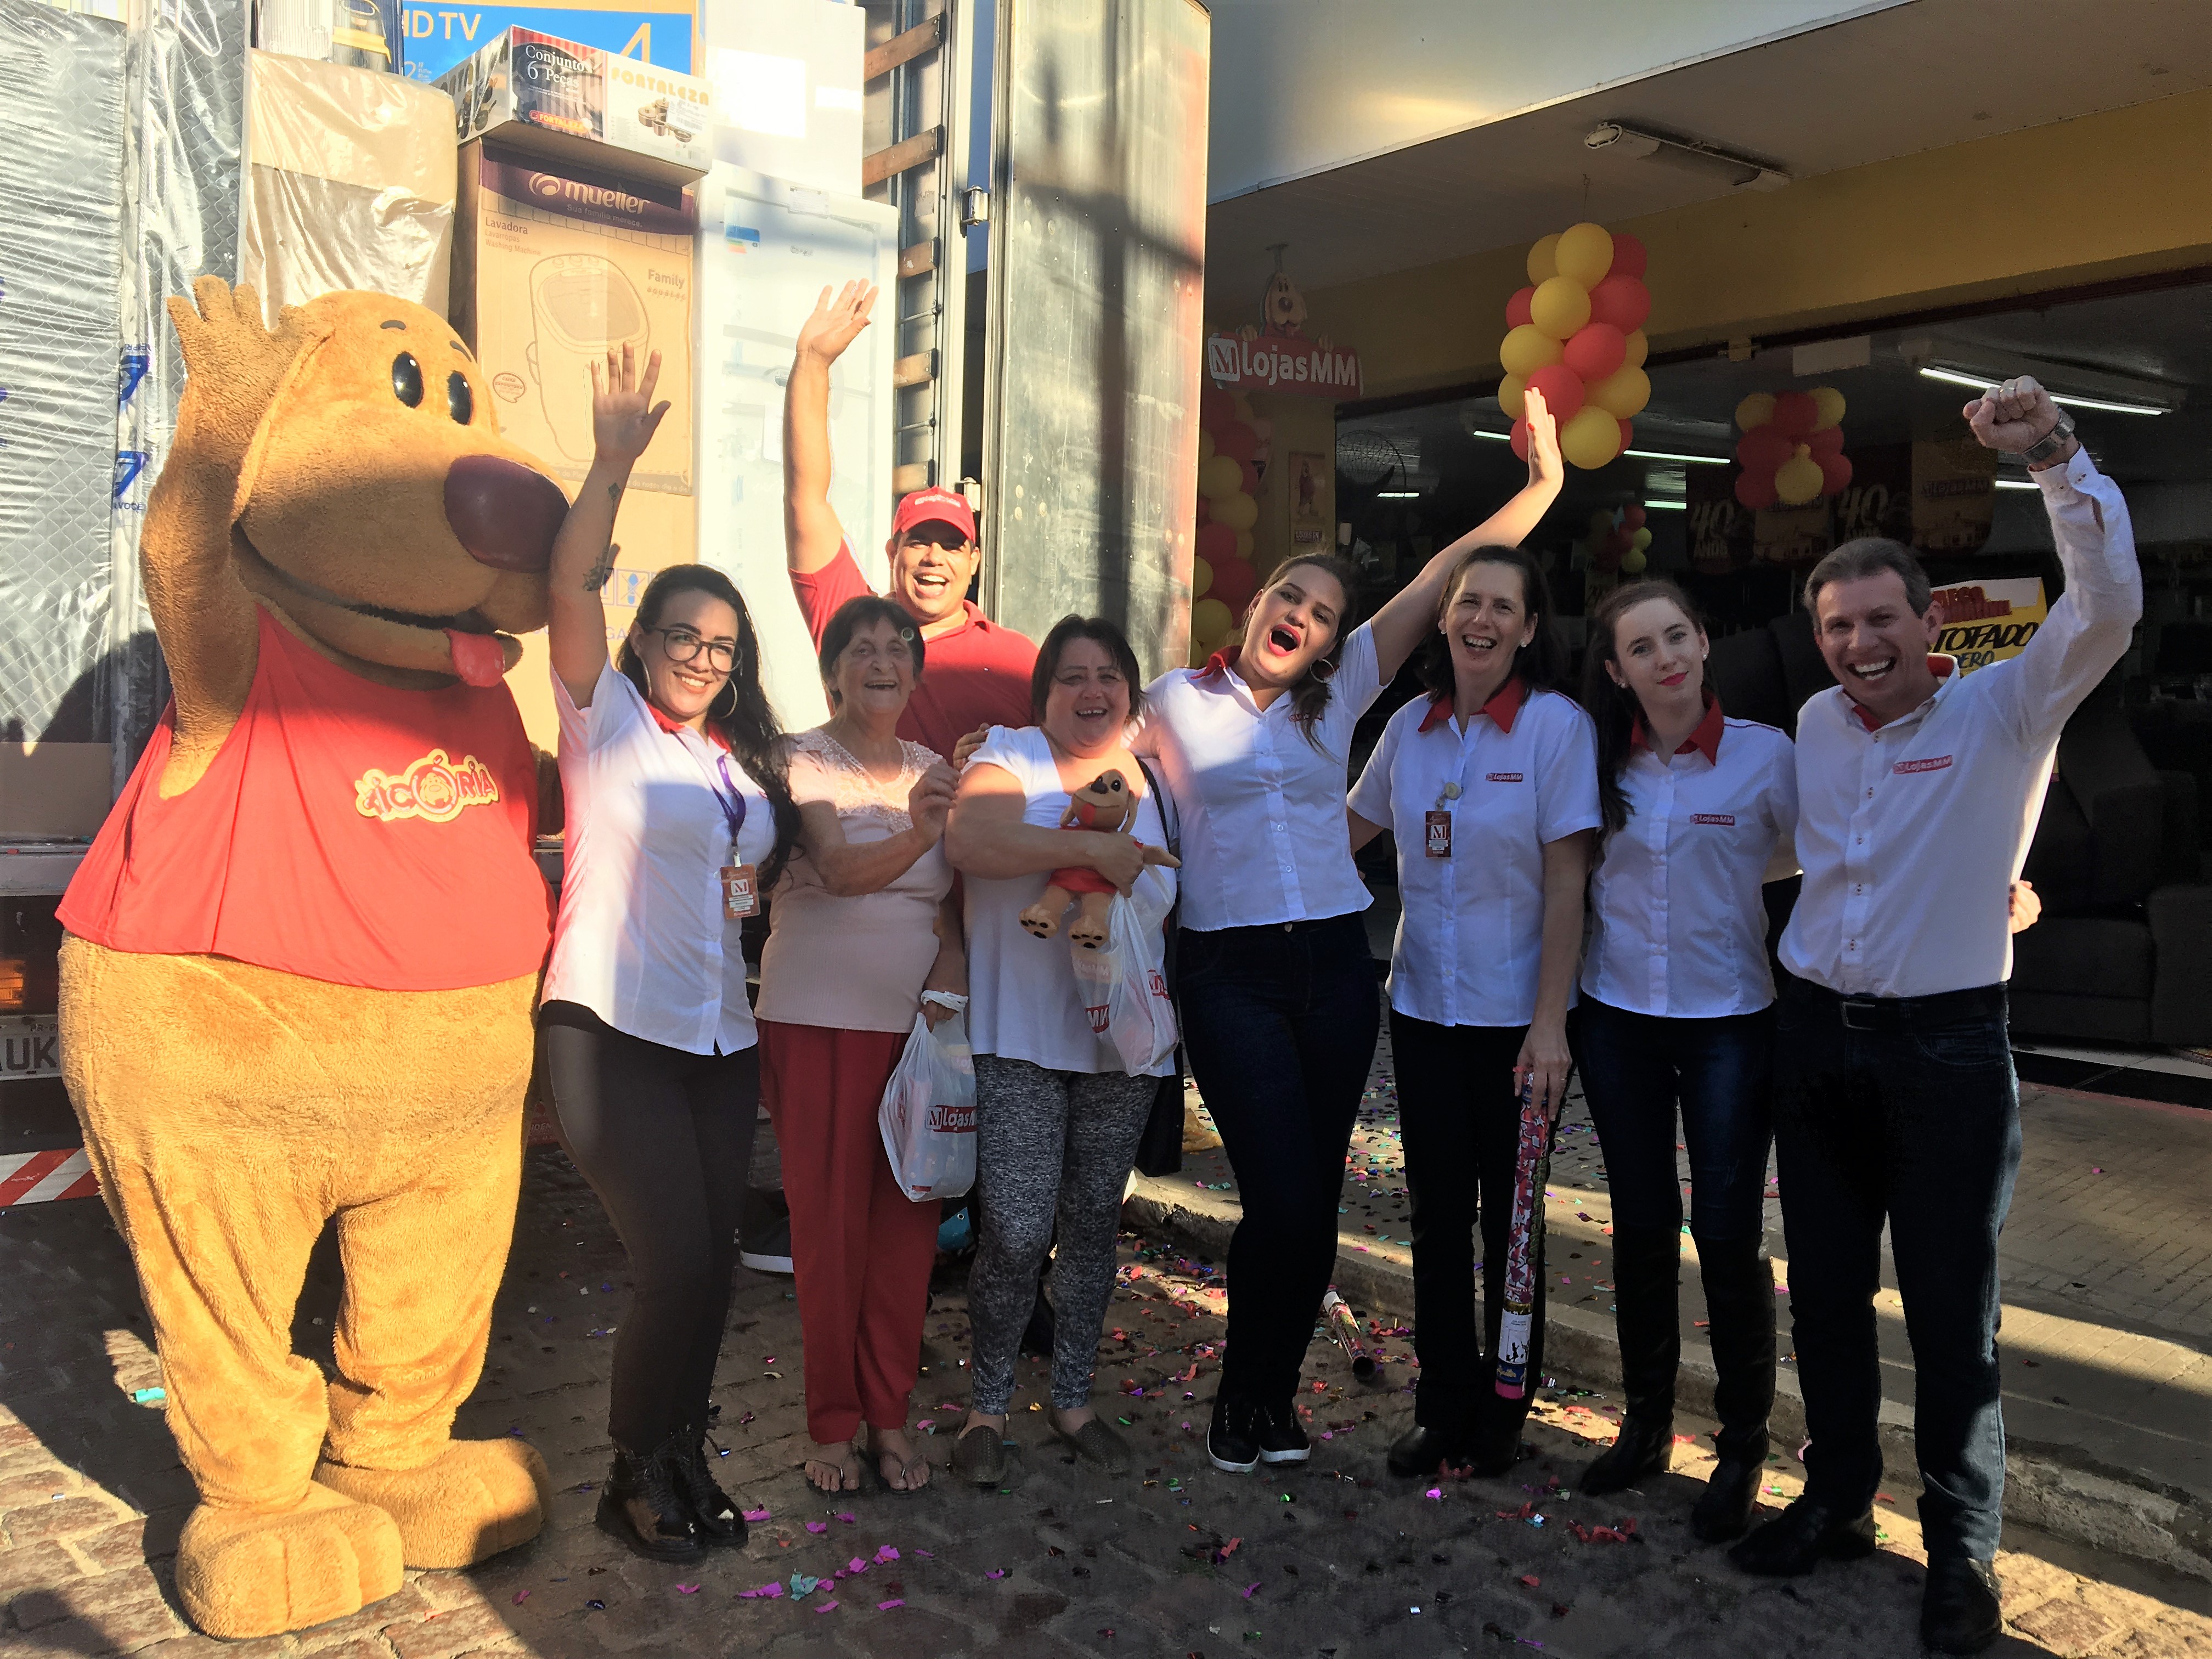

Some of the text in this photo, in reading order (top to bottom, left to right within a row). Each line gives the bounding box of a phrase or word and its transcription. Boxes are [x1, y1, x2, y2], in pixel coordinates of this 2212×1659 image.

[439, 12, 481, 40] TV
[526, 45, 584, 72] Conjunto
[527, 60, 579, 88] 6 Peças
[611, 66, 709, 106] FORTALEZA
[565, 180, 651, 215] mueller
[485, 229, 520, 242] Lavarropas
[486, 217, 528, 234] Lavadora
[486, 239, 512, 252] Washing
[648, 268, 685, 289] Family
[1690, 499, 1735, 539] 40
[1838, 483, 1888, 527] 40
[1694, 539, 1729, 558] ANOS
[1932, 622, 2039, 653] TOFADO
[0, 1036, 57, 1071] UK
